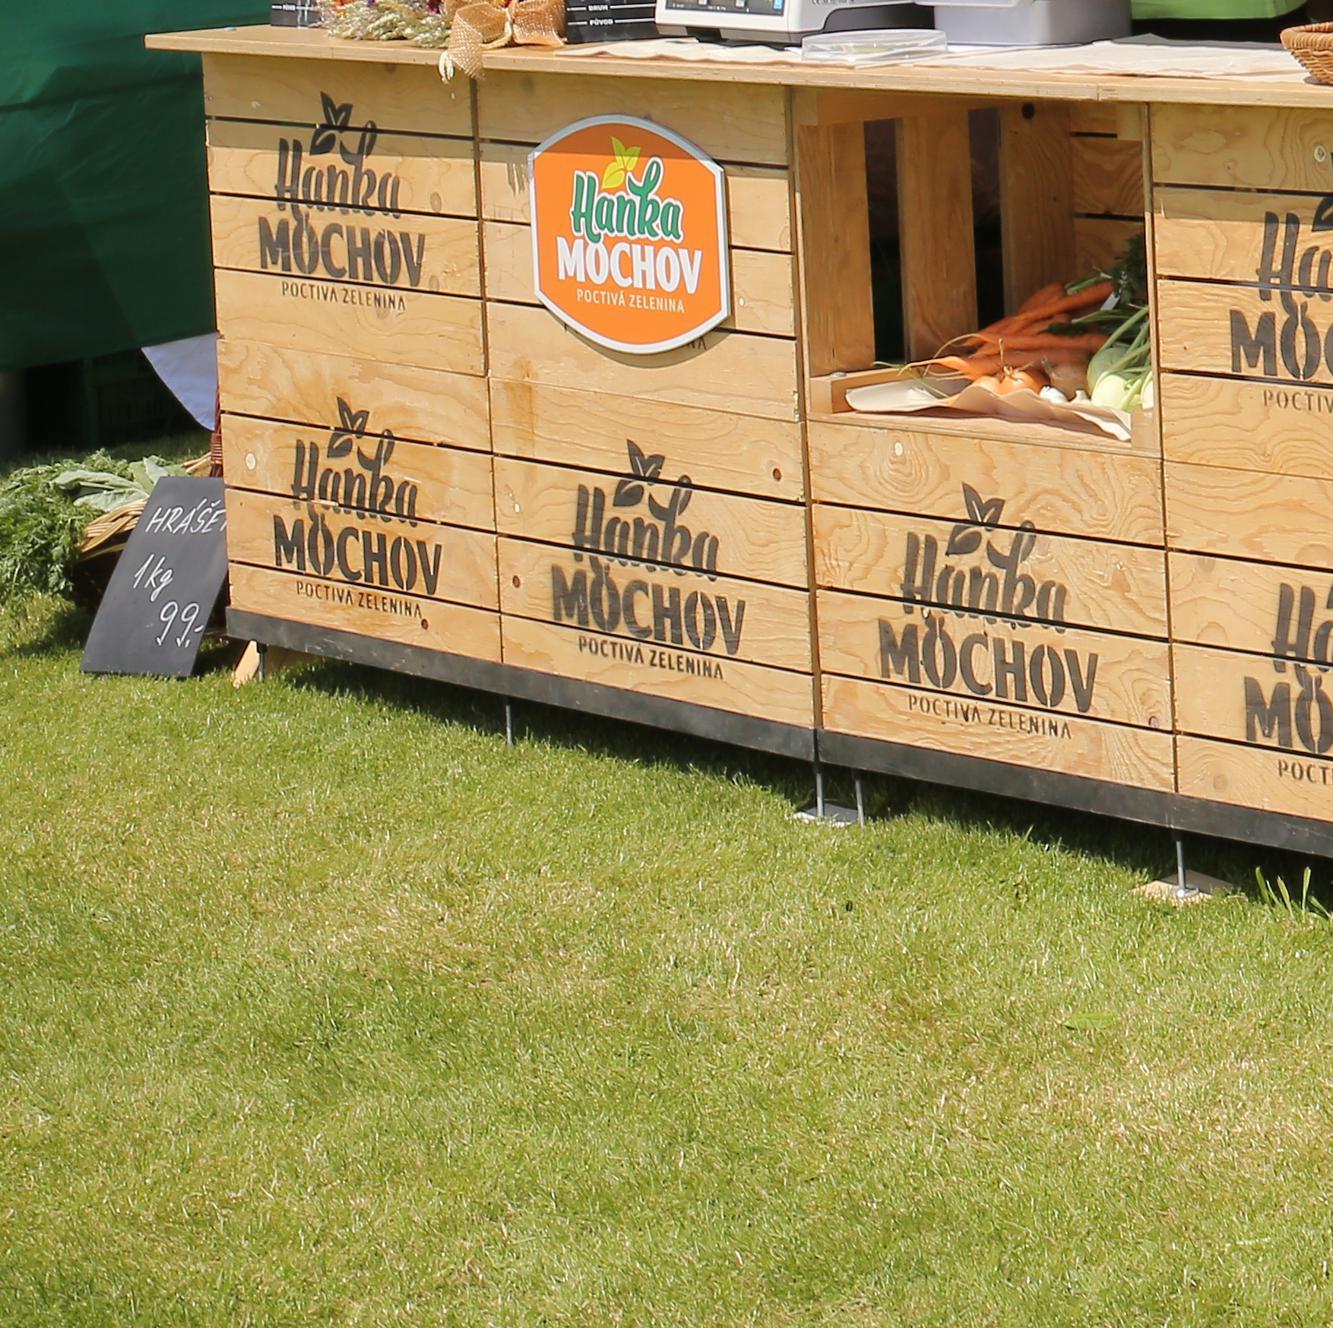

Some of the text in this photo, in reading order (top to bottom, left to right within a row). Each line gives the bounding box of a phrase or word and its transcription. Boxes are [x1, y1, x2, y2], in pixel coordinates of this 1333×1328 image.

[275, 120, 402, 221] Hanka
[570, 157, 684, 244] Hanka
[257, 213, 426, 288] MOCHOV
[556, 235, 702, 295] MOCHOV
[341, 287, 407, 312] ZELENINA
[577, 288, 686, 314] POCTIVÁ ZELENINA
[145, 498, 228, 535] HRÁŠE
[291, 428, 419, 527] Hanka
[273, 513, 443, 596] MOCHOV
[572, 474, 720, 582] Hanka
[357, 590, 422, 619] ZELENINA
[551, 563, 746, 656] MOCHOV
[900, 520, 1068, 634] Hanka
[648, 649, 723, 680] ZELENINA
[878, 617, 1099, 713] MOCHOV
[987, 708, 1072, 740] ZELENINA
